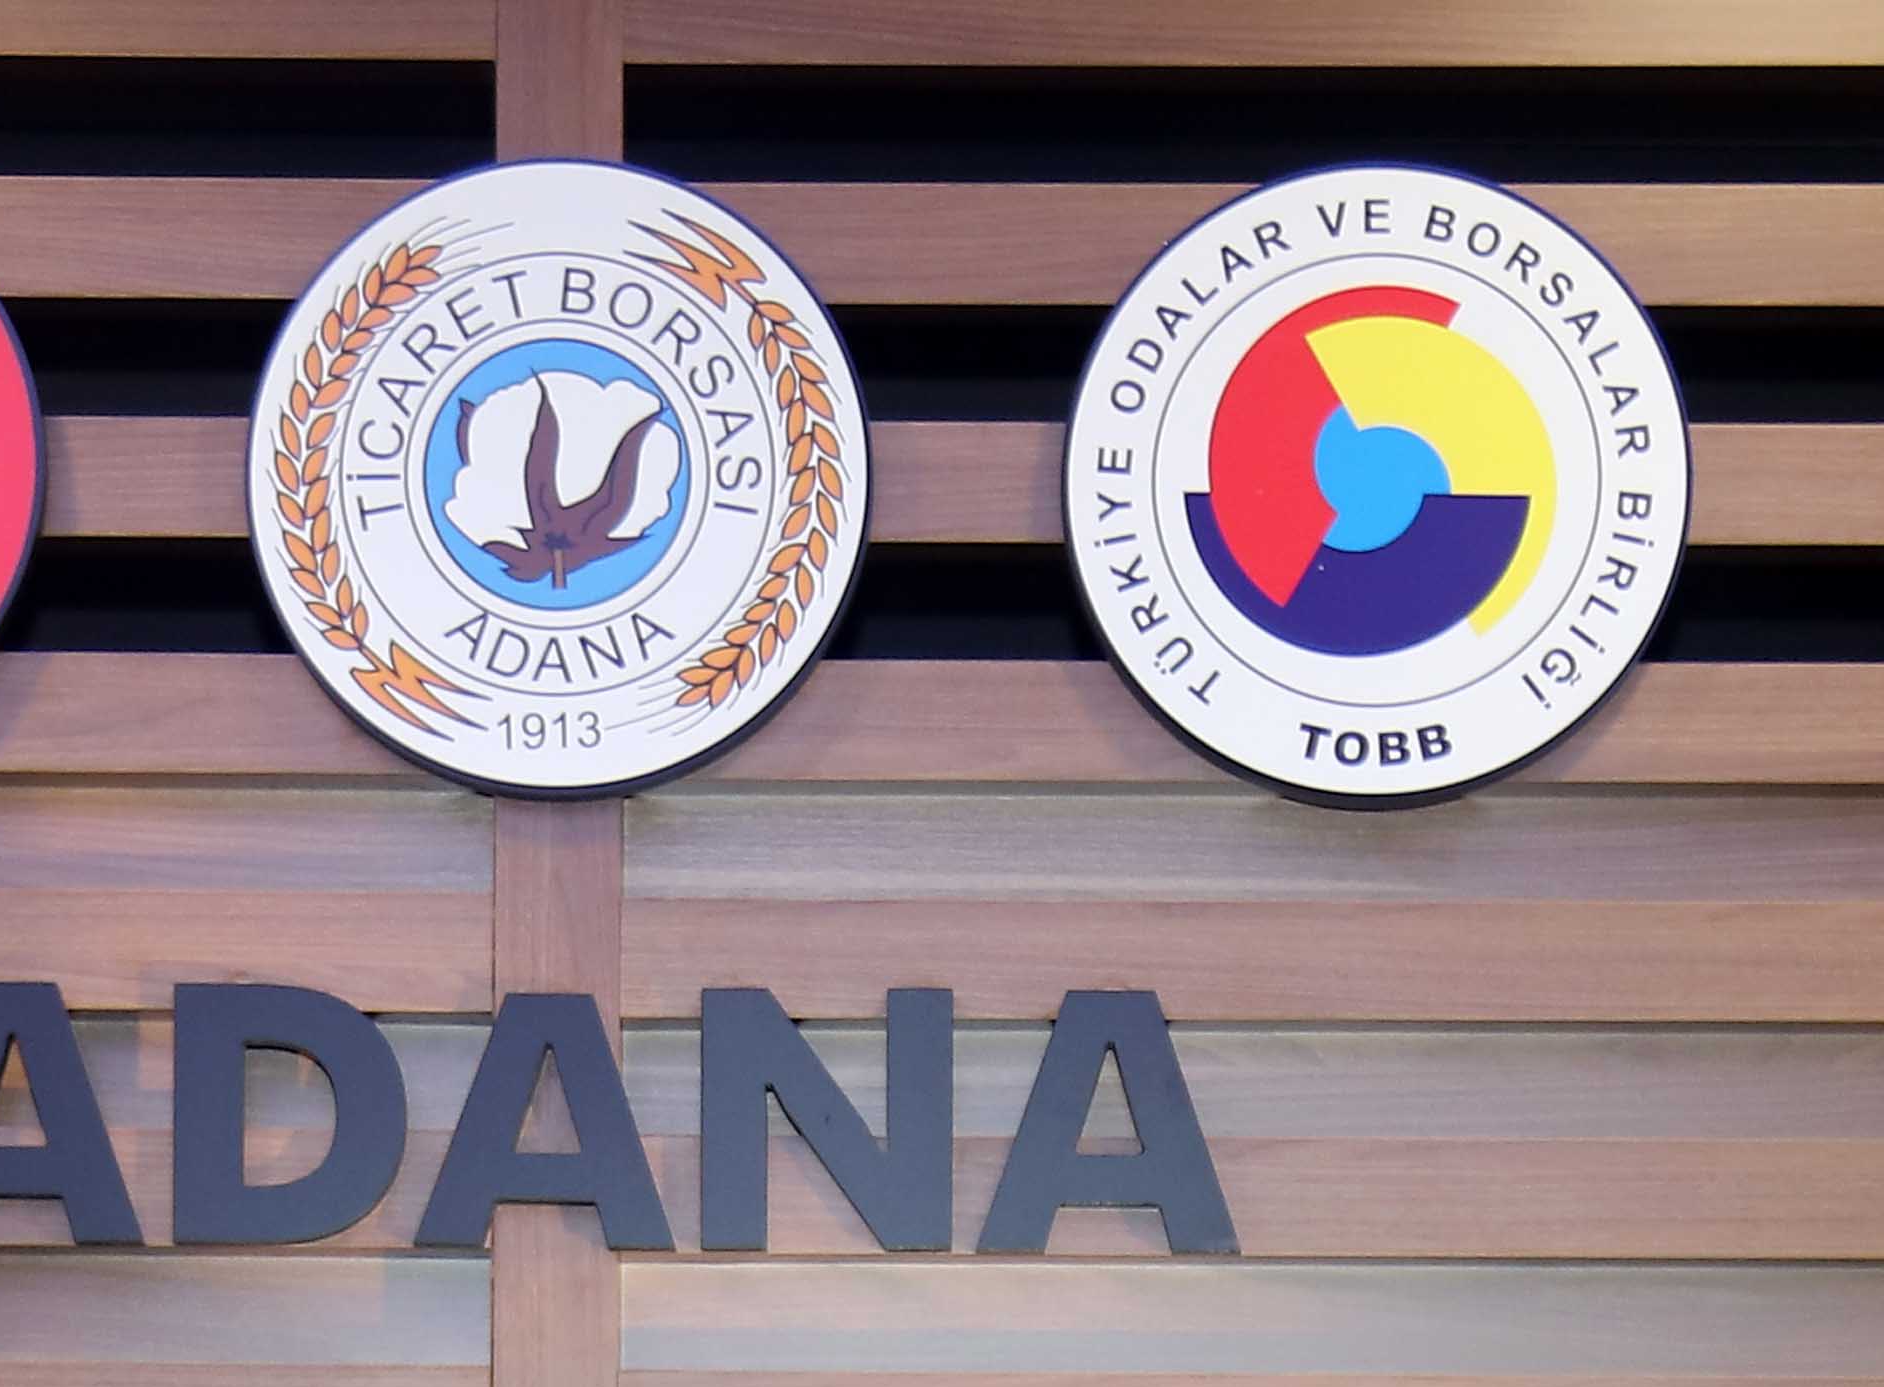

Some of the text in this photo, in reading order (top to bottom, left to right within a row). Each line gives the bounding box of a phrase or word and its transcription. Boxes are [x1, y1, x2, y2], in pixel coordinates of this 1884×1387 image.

[346, 267, 763, 532] TİCARET BORSASI
[1094, 199, 1655, 710] TÜRKİYE ODALAR VE BORSALAR BİRLİĞİ
[444, 611, 675, 684] ADANA
[496, 711, 602, 751] 1913
[1299, 722, 1453, 767] TOBB
